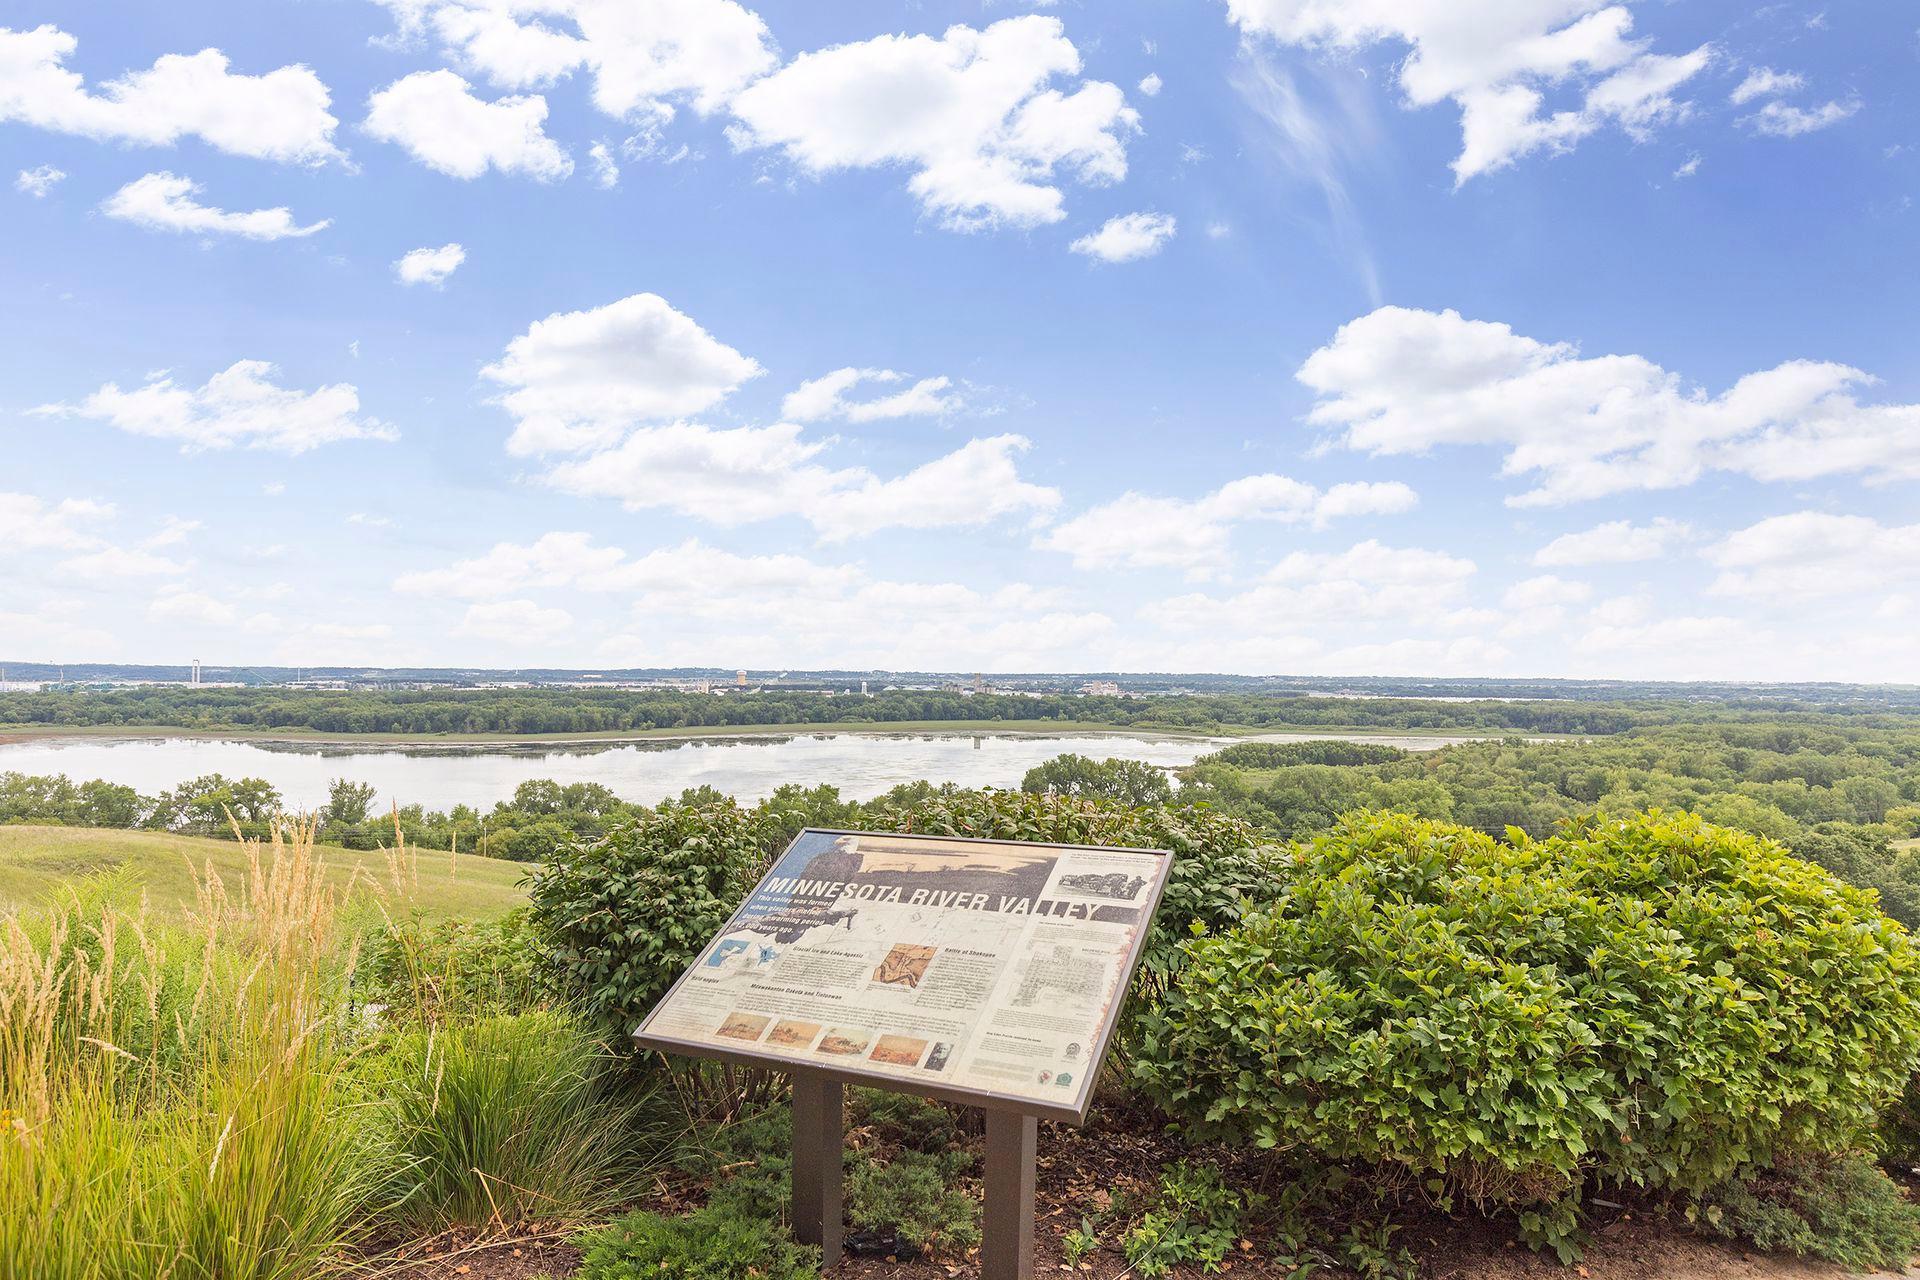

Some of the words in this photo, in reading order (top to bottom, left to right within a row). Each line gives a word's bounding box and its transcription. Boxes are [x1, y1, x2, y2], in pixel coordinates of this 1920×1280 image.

[764, 877, 904, 903] MINNESOTA
[908, 888, 990, 911] RIVER
[998, 896, 1101, 921] VALLEY
[772, 897, 793, 905] valley
[808, 899, 834, 907] formed
[770, 915, 801, 925] warming
[801, 918, 826, 927] period
[969, 950, 996, 958] Shakopee
